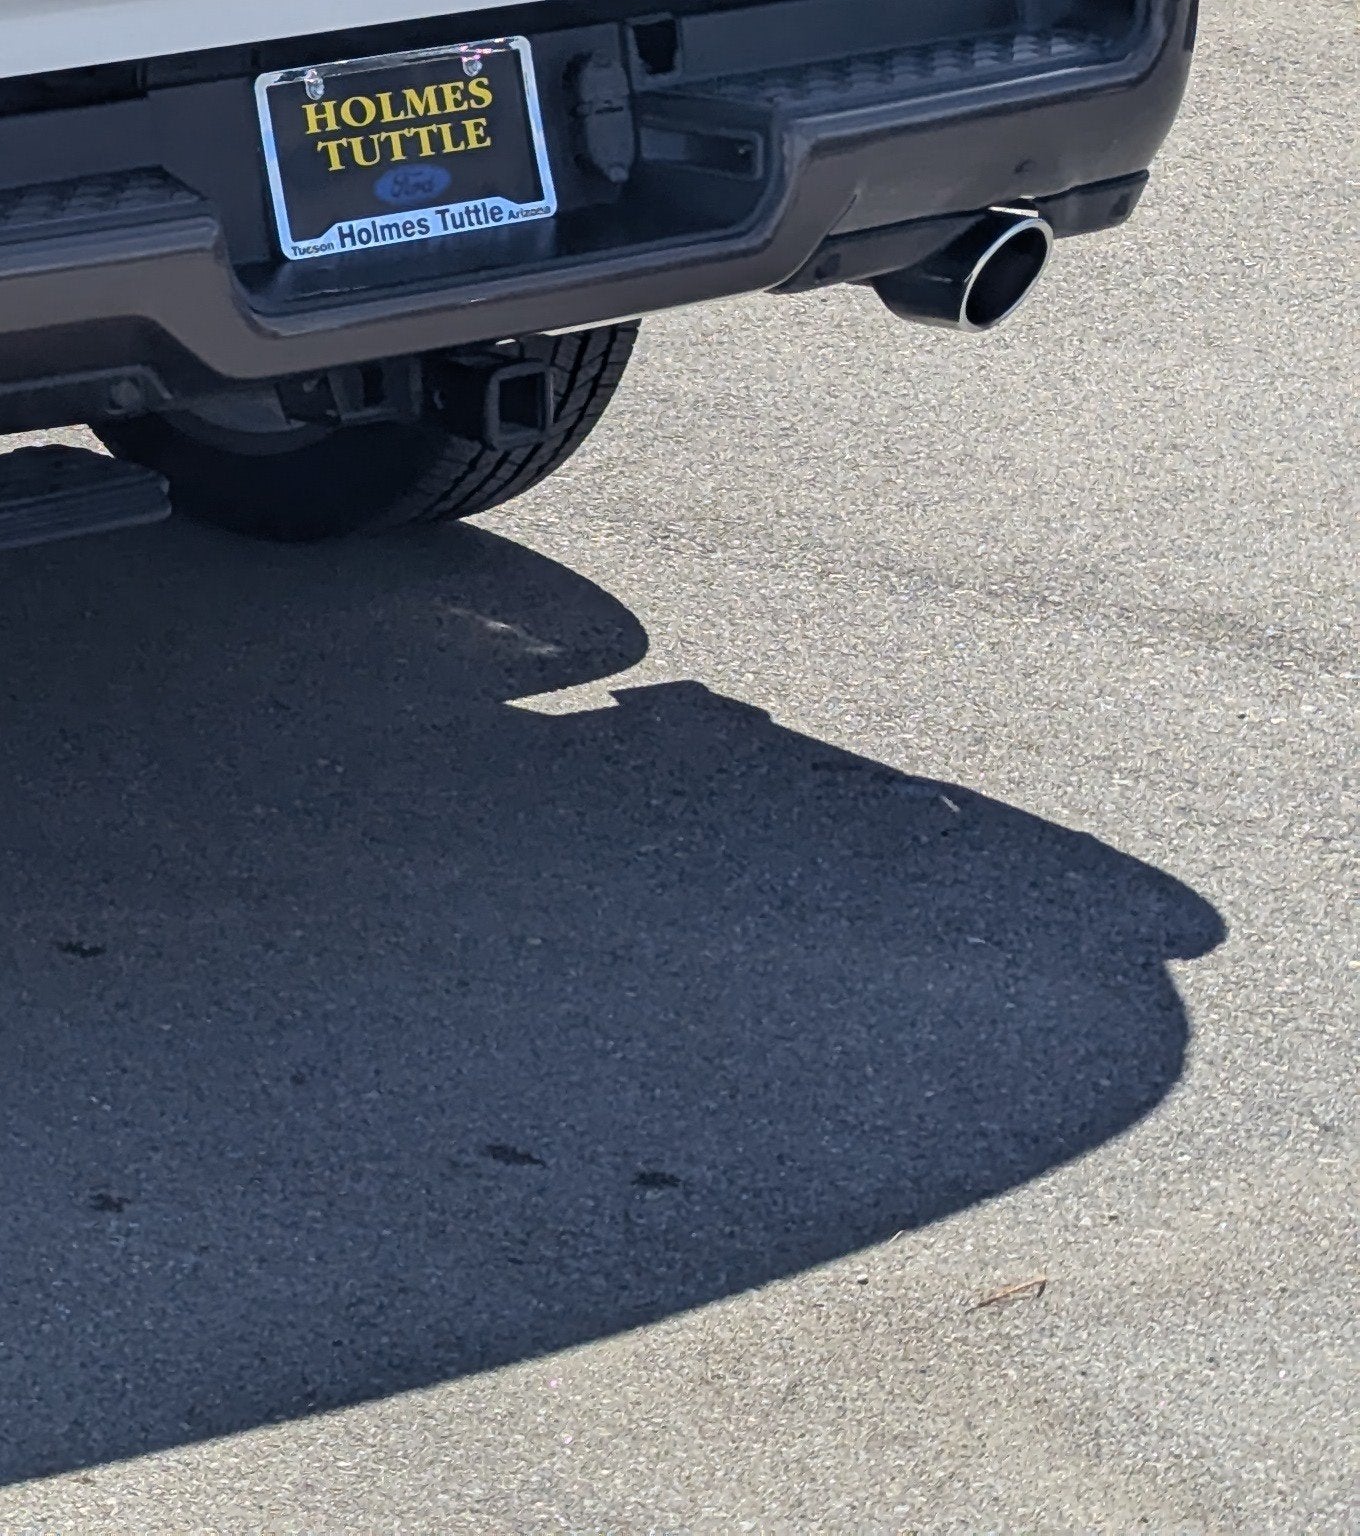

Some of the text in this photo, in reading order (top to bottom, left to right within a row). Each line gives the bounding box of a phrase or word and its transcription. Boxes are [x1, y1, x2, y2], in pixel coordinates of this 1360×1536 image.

[301, 76, 493, 135] HOLMES
[317, 117, 492, 172] TUTTLE
[290, 240, 334, 257] Tucson
[337, 215, 431, 249] Holmes
[435, 201, 504, 232] Tuttle
